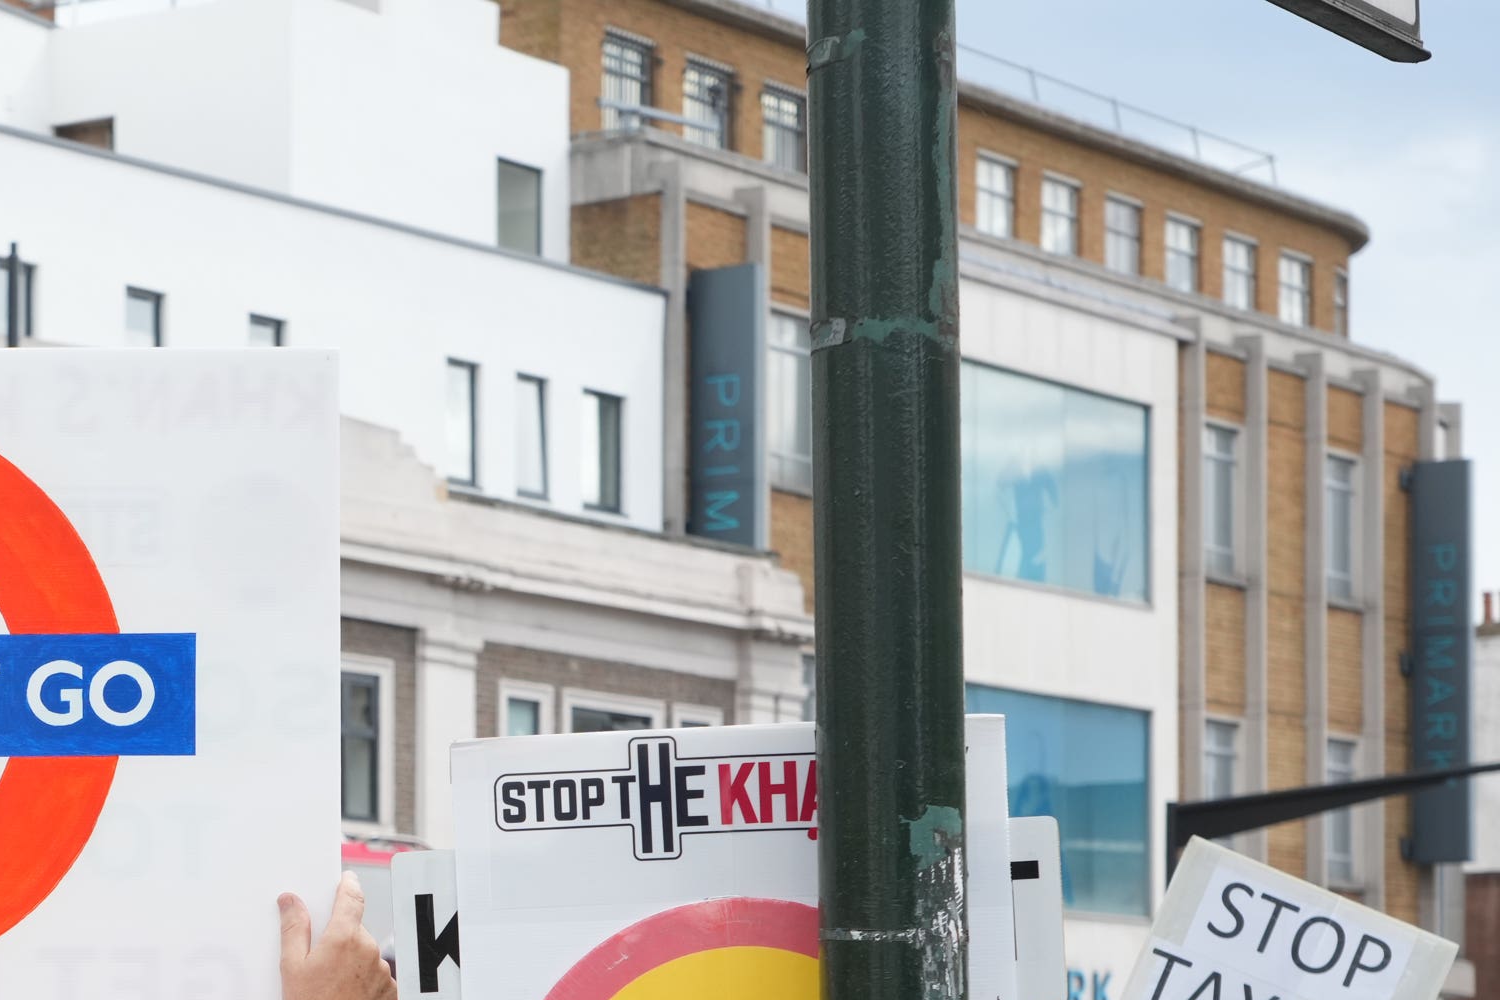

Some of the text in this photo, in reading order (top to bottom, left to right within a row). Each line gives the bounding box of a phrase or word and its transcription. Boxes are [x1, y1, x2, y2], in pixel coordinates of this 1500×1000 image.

[704, 373, 741, 532] PRIM
[26, 659, 156, 727] GO
[502, 777, 604, 823] STOP
[611, 742, 709, 854] THE
[1207, 882, 1392, 987] STOP
